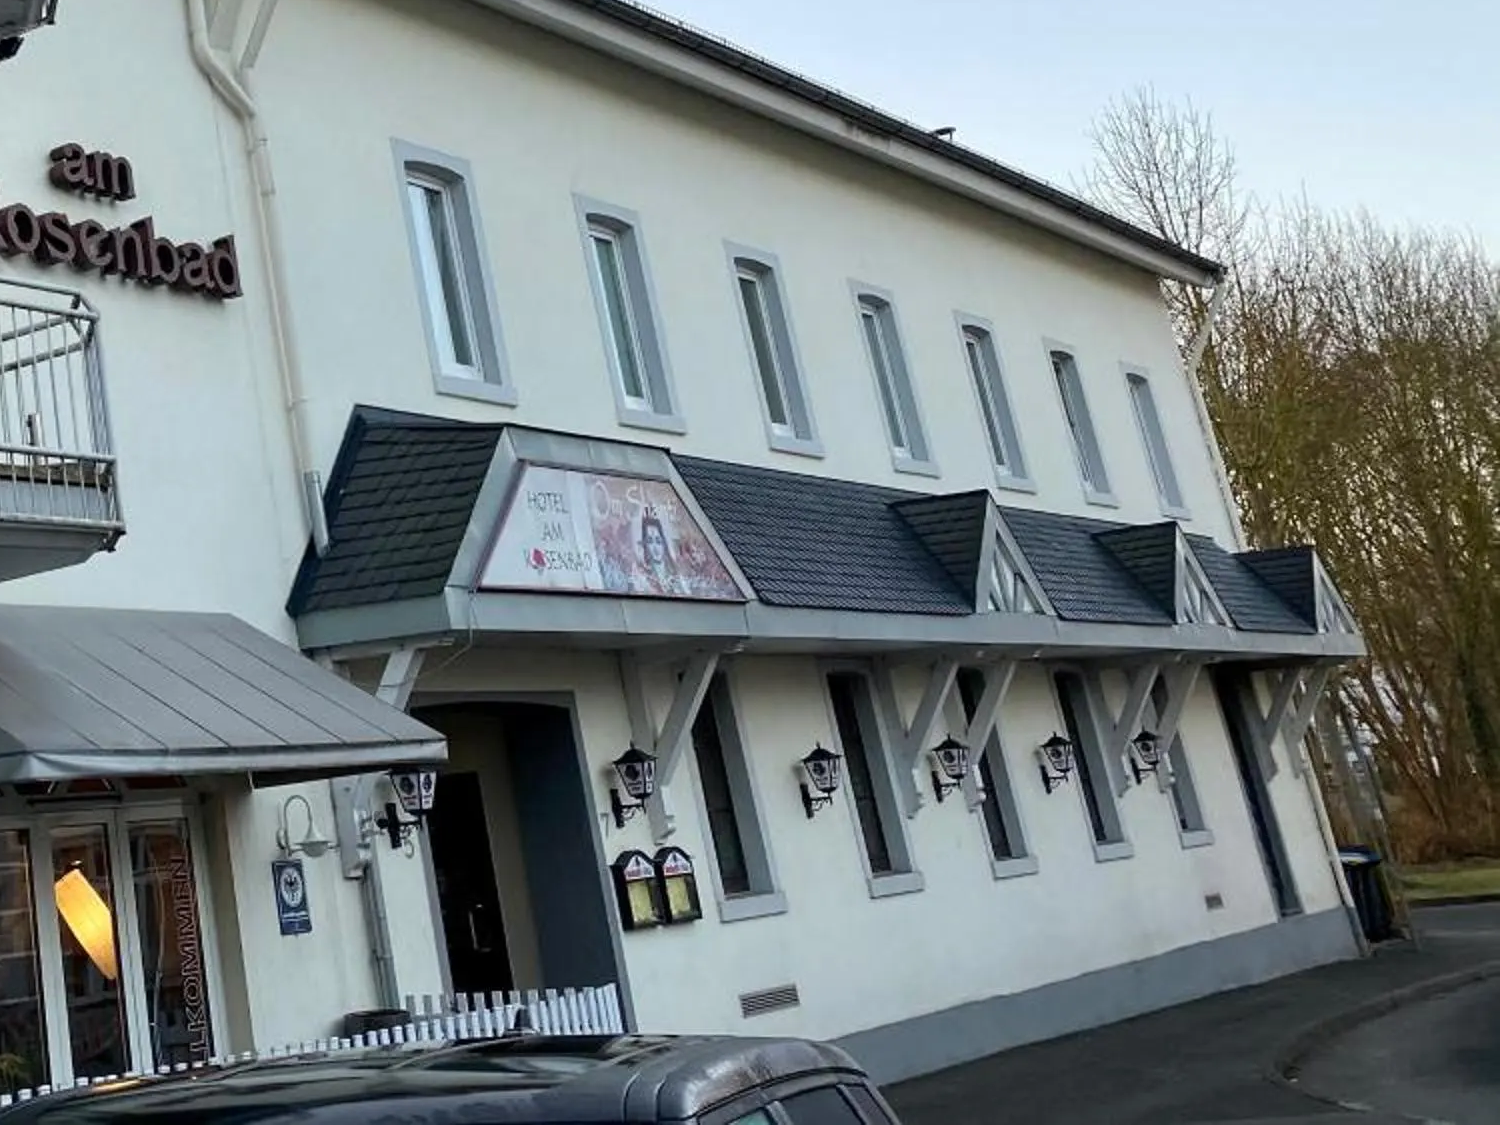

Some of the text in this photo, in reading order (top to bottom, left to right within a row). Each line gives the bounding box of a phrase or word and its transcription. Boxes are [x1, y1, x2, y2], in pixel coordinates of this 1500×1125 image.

[49, 142, 137, 202] am
[526, 490, 570, 514] HOTEL
[541, 522, 565, 541] AM
